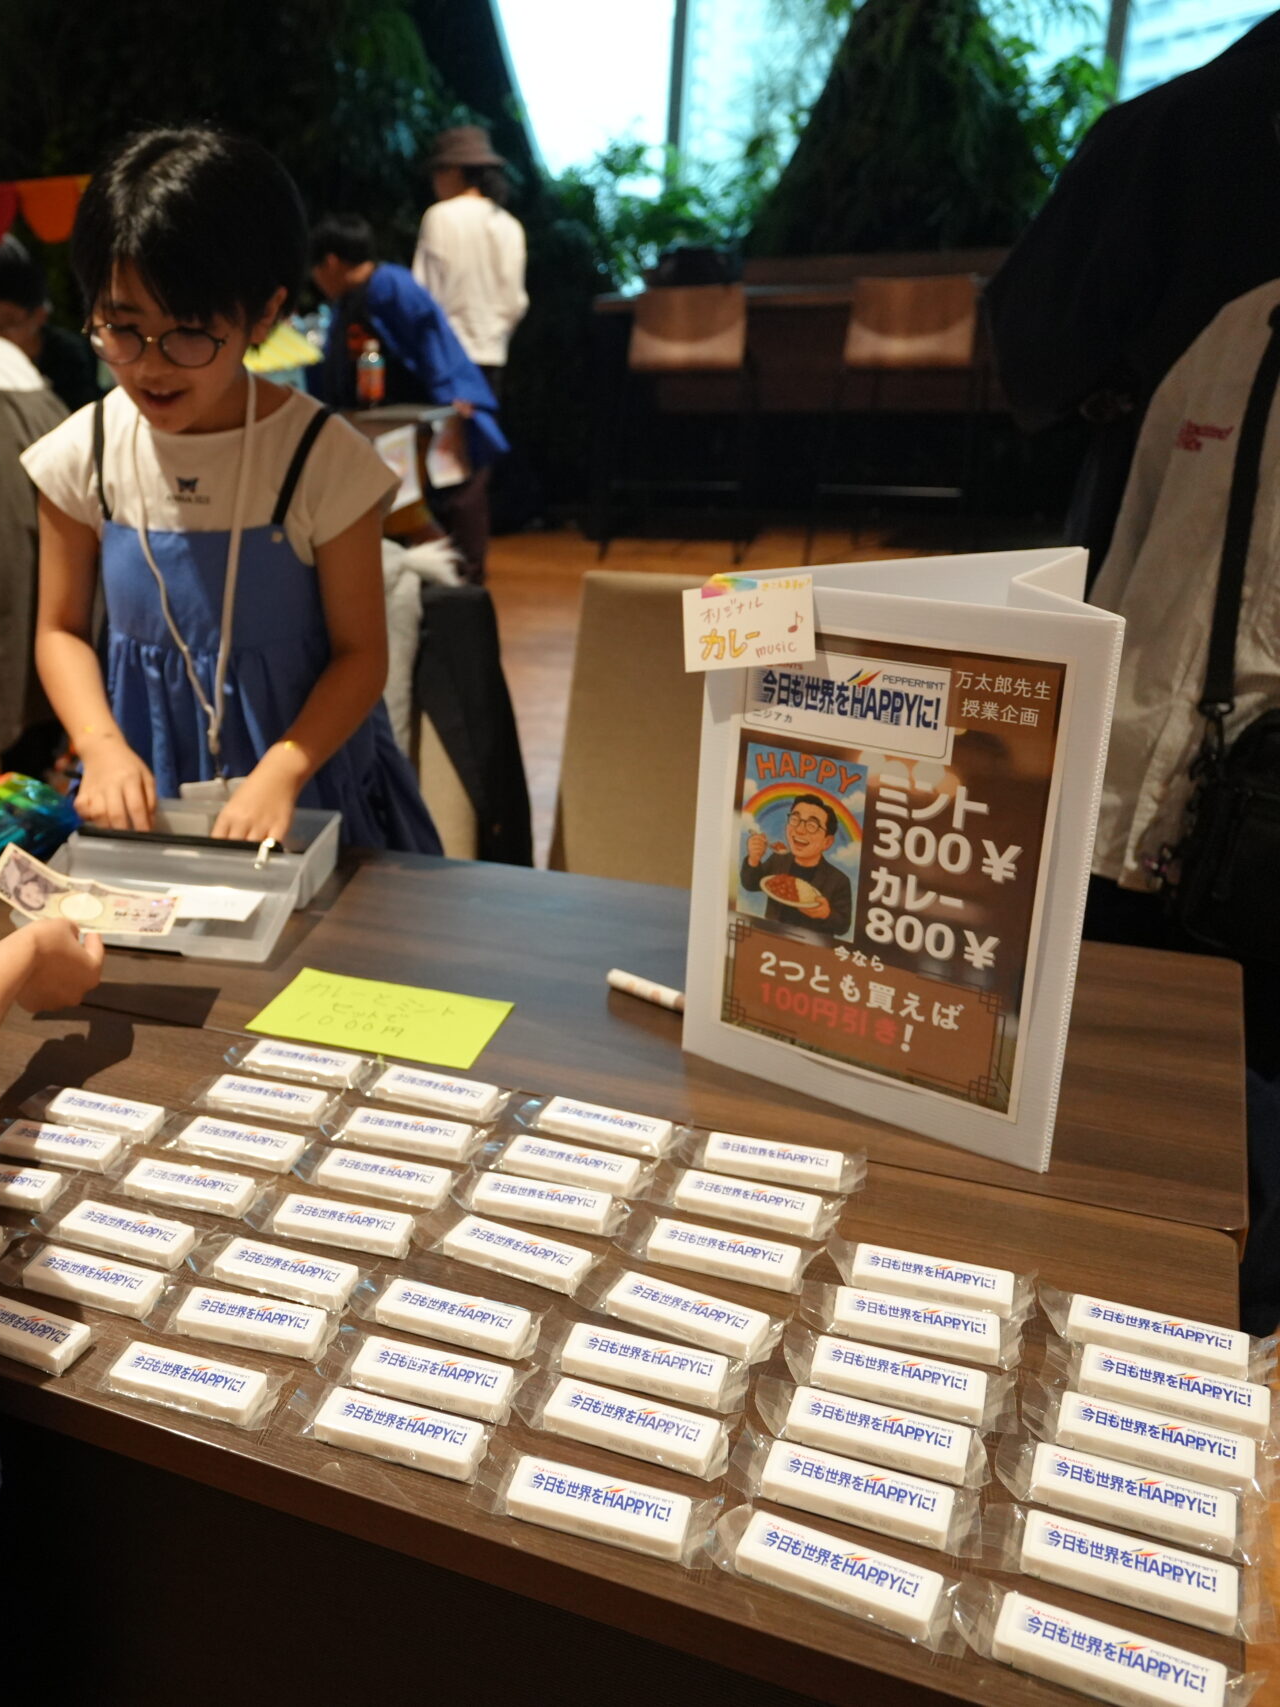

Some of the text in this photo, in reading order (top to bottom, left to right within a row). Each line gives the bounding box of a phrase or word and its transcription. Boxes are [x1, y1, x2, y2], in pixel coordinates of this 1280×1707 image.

[699, 626, 762, 661] カレー
[882, 672, 947, 692] PEPPERMINT
[955, 669, 1052, 701] 万太郎先生
[961, 698, 1040, 728] 授業企画
[754, 750, 863, 795] HAPPY
[874, 775, 990, 831] ミント
[867, 864, 965, 911] カレー
[833, 943, 885, 973] 今なら
